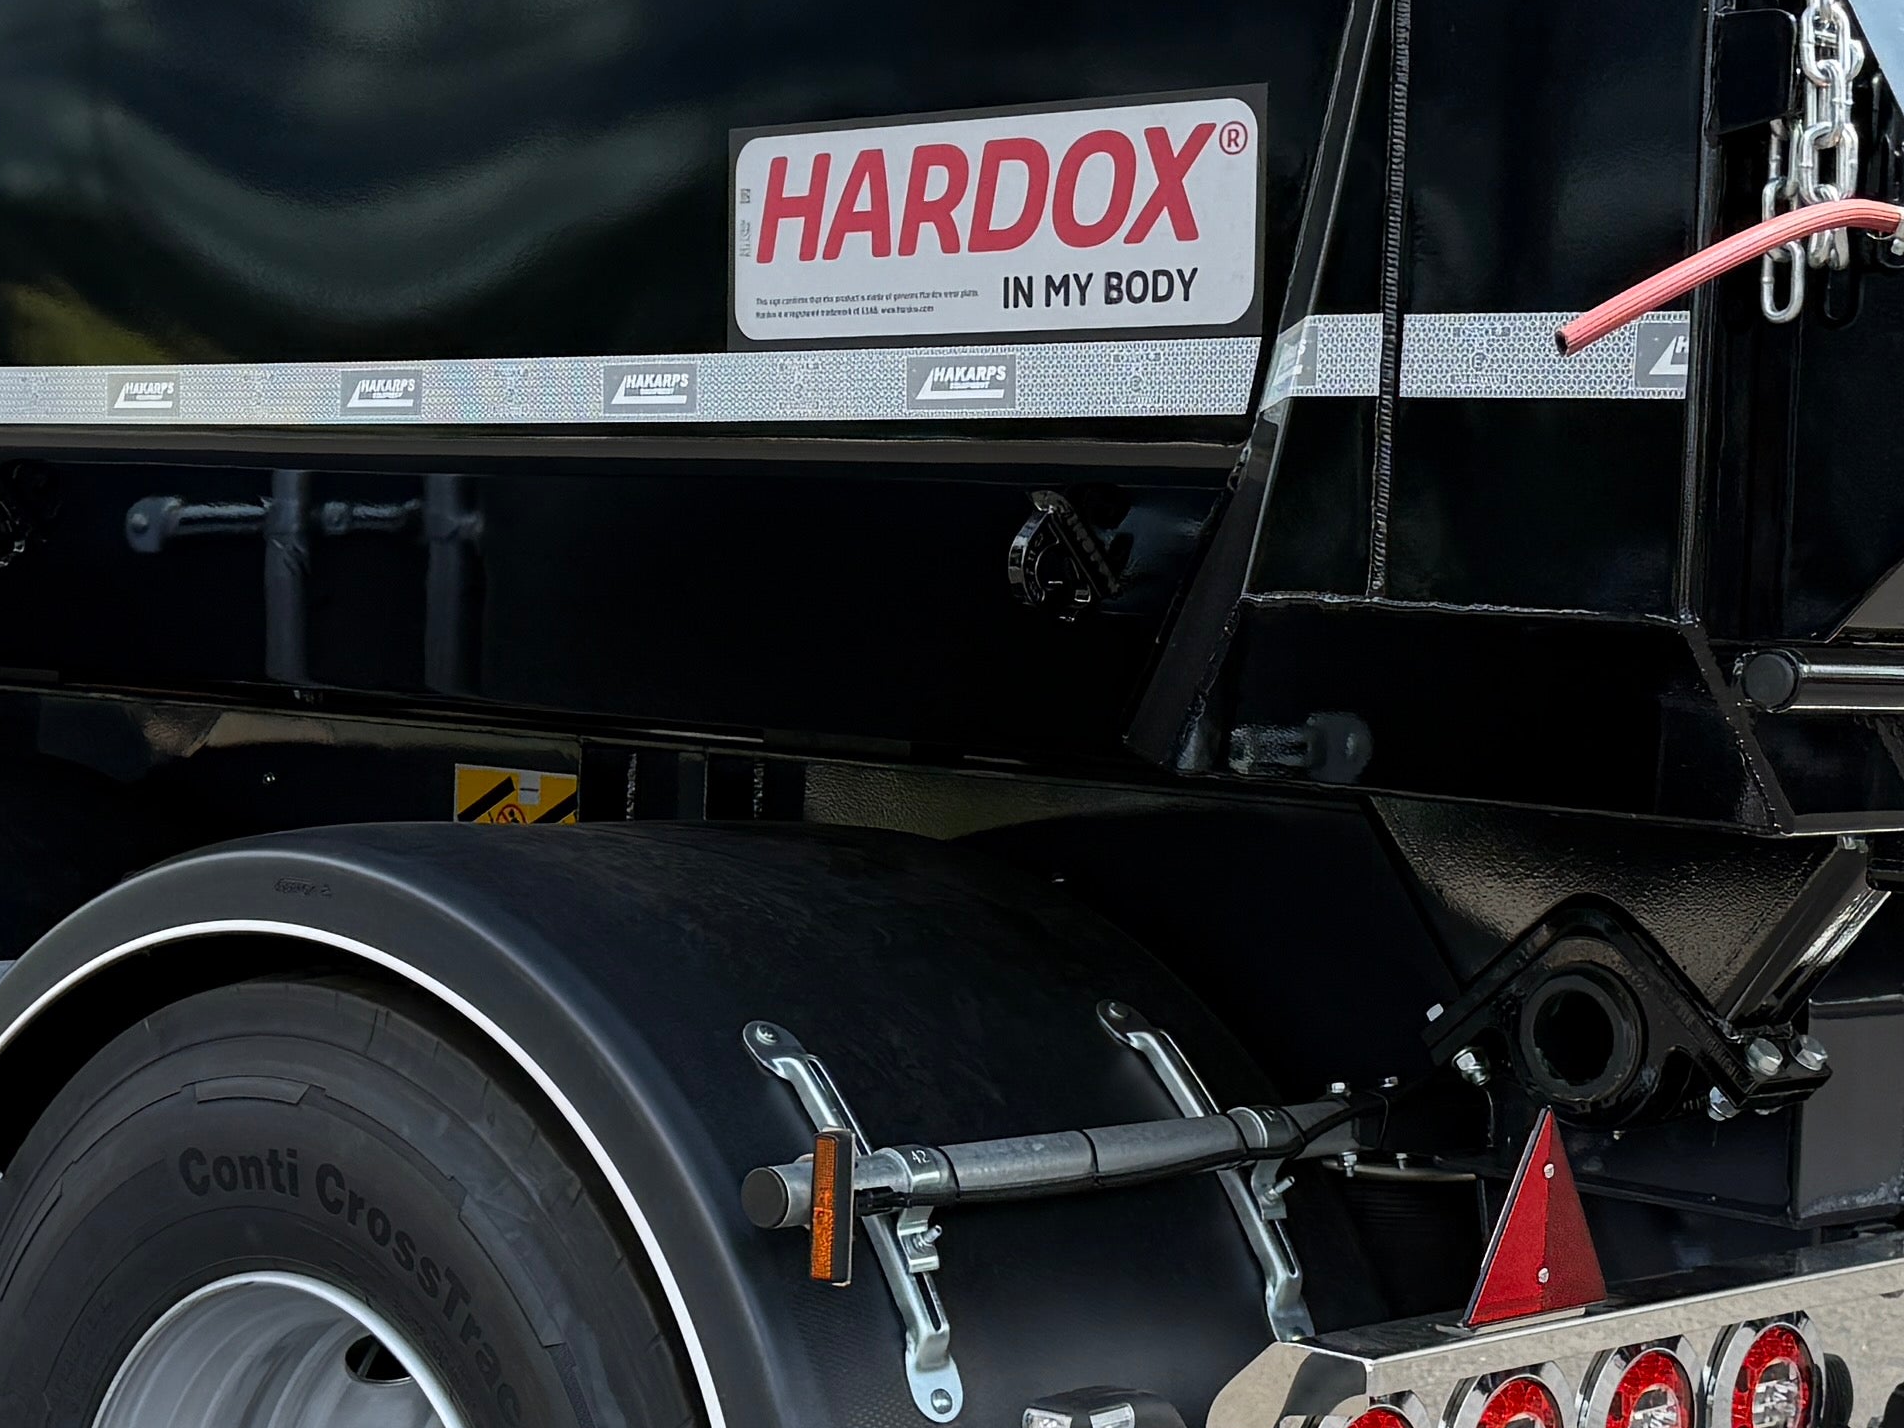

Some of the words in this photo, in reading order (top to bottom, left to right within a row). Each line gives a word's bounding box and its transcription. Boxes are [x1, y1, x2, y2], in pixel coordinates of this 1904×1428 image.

[1002, 275, 1034, 310] IN
[1044, 271, 1093, 308] MY
[1103, 267, 1199, 306] BODY
[625, 373, 690, 388] HAKARPS
[933, 365, 1007, 381] HAKARPS
[360, 378, 416, 392] HAKARPS
[177, 1146, 301, 1198] Conti
[314, 1163, 523, 1428] CrossTrac
